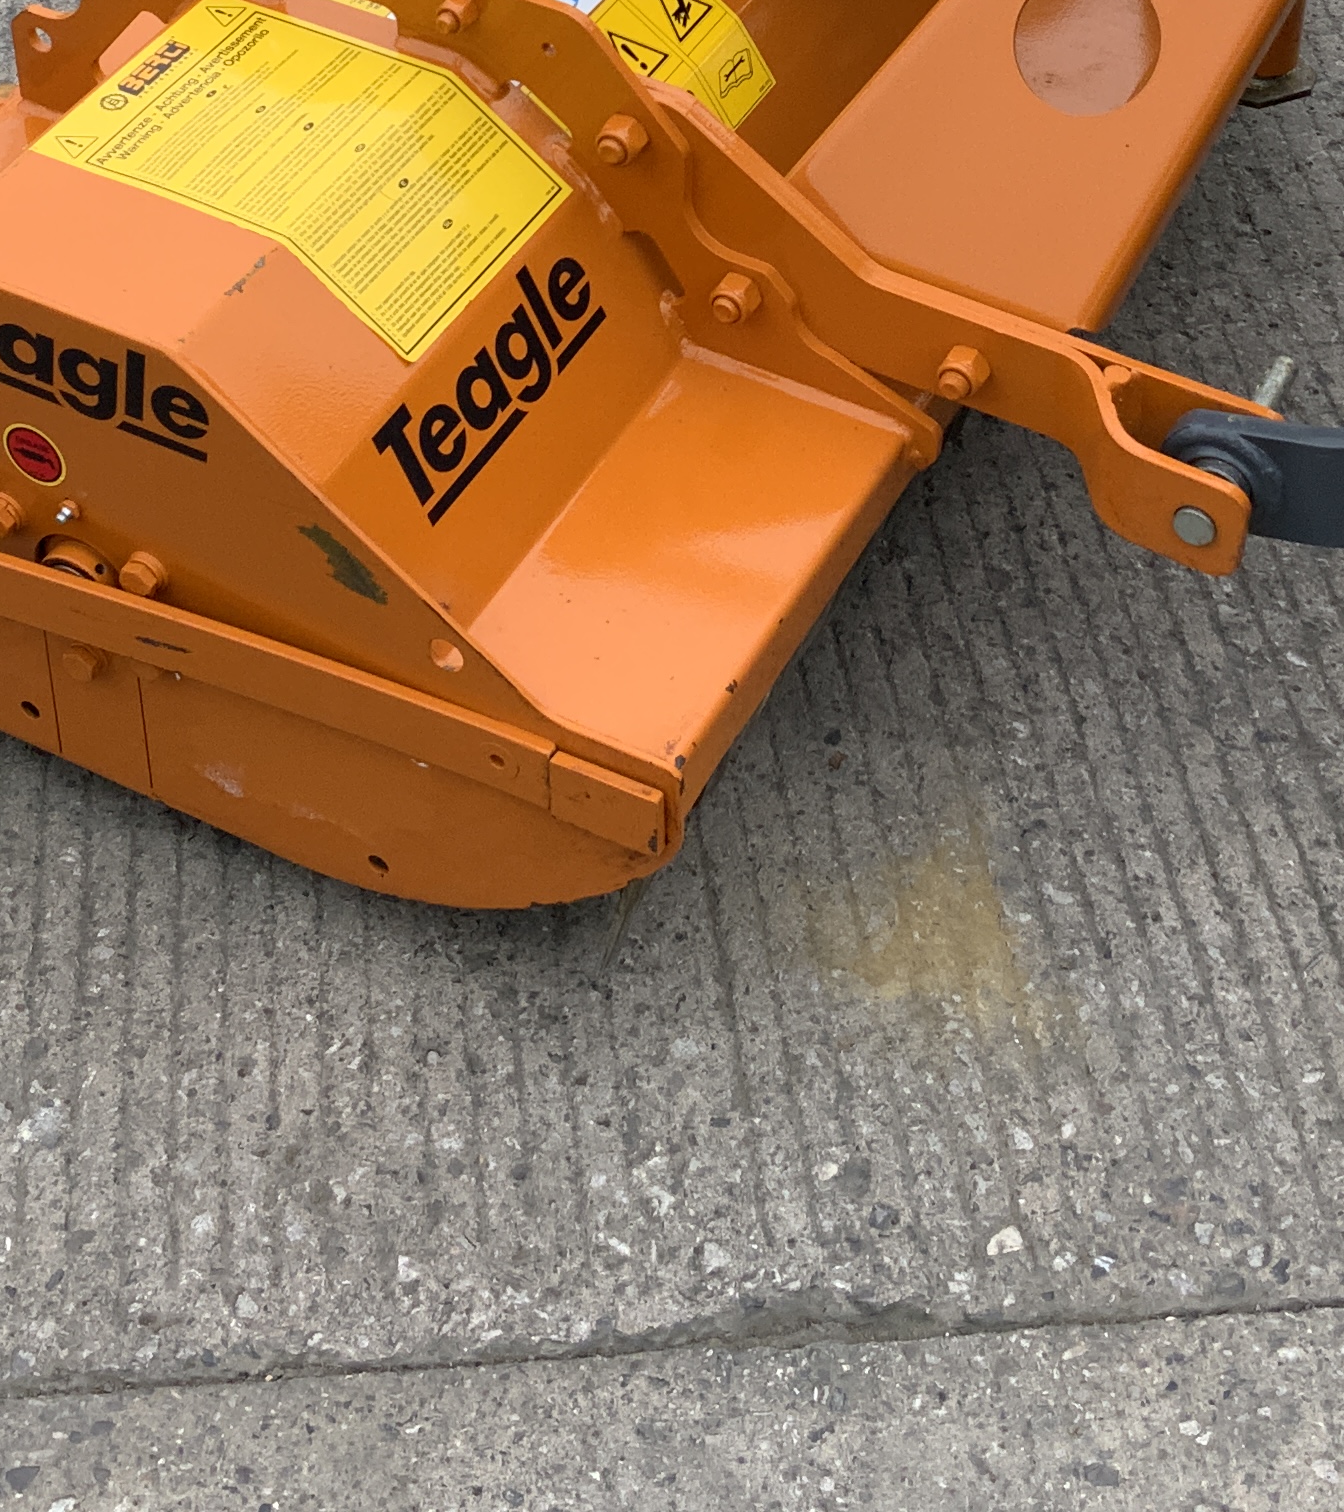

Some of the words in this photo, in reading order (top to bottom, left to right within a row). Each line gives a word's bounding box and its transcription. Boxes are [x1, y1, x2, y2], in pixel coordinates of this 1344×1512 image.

[96, 117, 153, 165] Avvertenze
[155, 77, 200, 112] Achtung
[199, 17, 267, 74] Avertissement
[116, 124, 163, 160] Warning
[163, 71, 222, 119] Advertencia
[371, 257, 591, 507] Teagle
